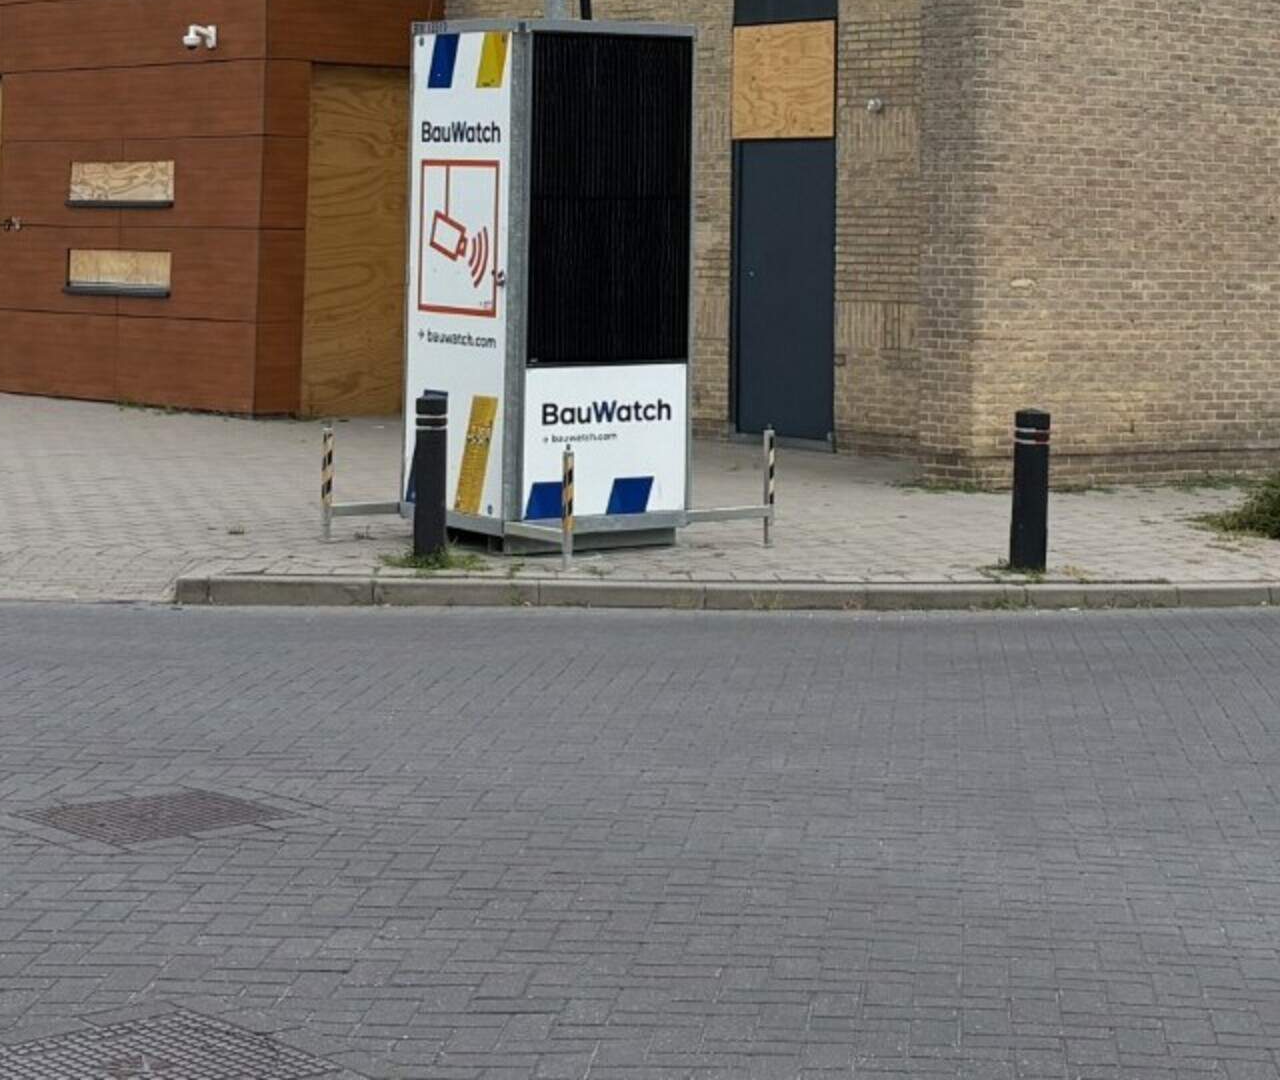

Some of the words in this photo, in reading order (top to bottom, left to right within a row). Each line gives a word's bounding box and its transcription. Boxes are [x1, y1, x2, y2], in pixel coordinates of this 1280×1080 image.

[421, 121, 501, 144] BauWatch
[427, 327, 496, 348] bauwatch.com
[542, 398, 671, 426] BauWatch
[551, 432, 617, 443] bauwatch.com
